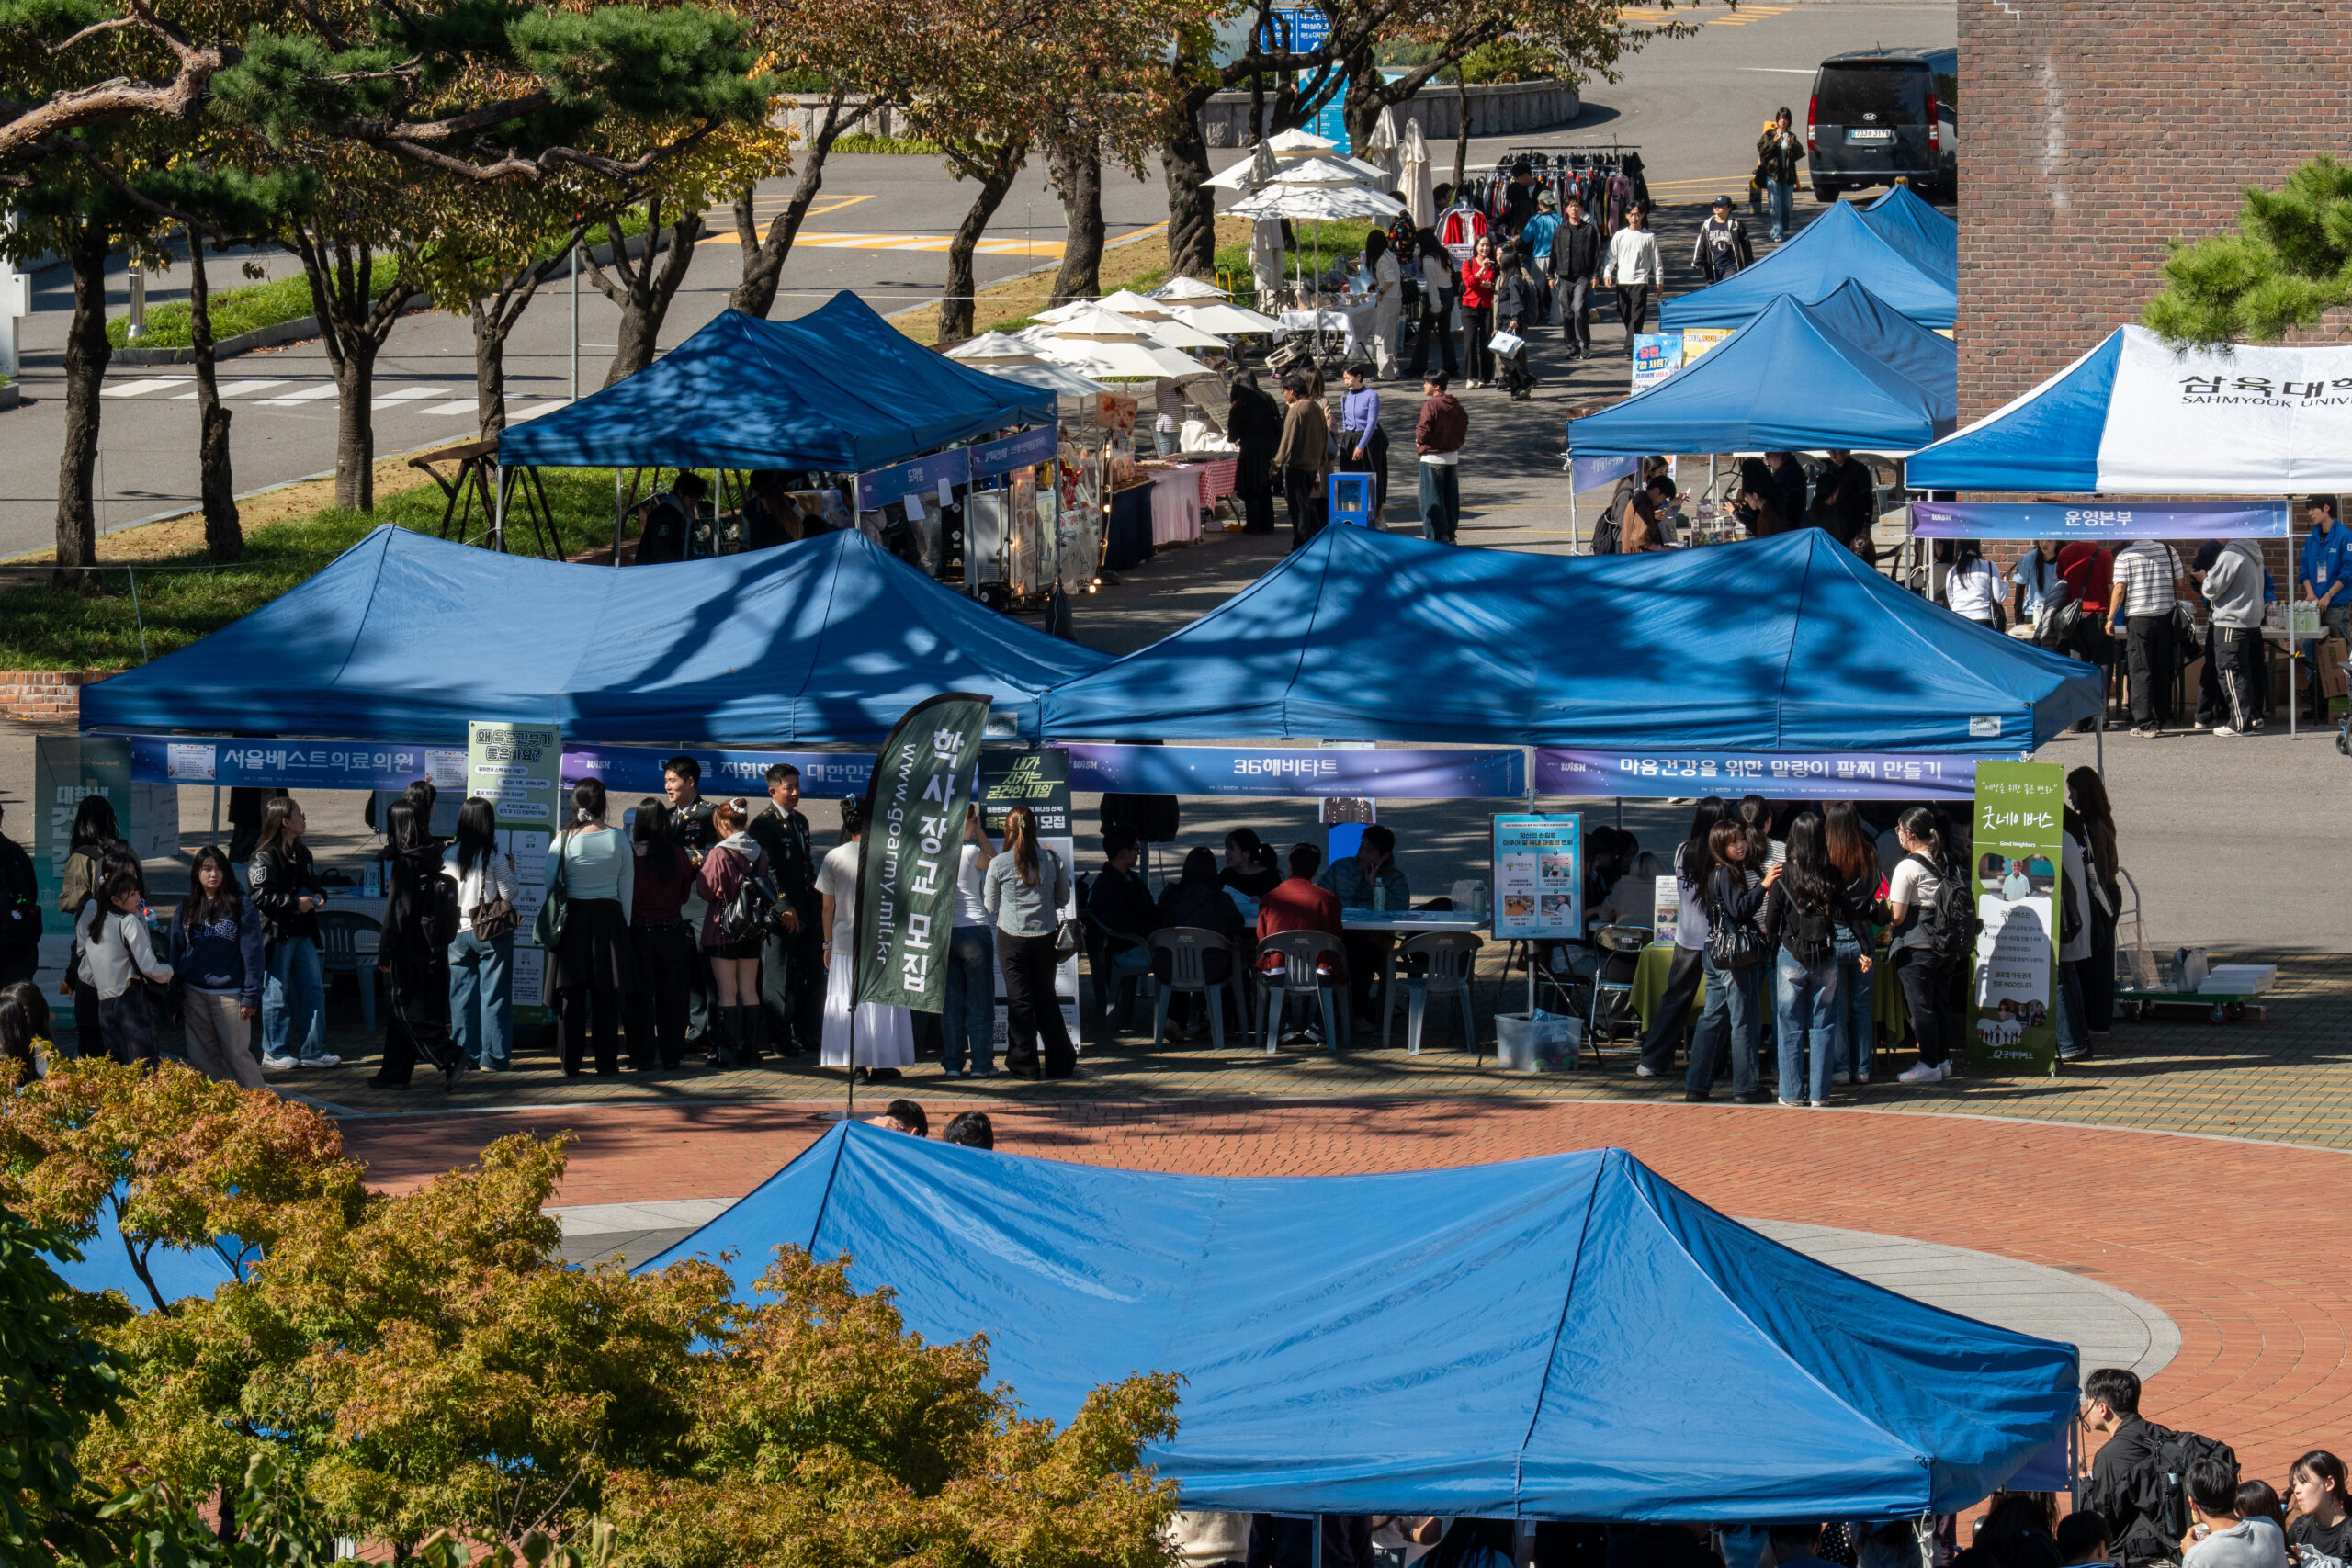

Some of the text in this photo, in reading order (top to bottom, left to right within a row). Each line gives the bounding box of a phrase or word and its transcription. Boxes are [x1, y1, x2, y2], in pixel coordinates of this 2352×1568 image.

[2181, 395, 2352, 409] SAHMYOOK UNIV
[2065, 510, 2132, 527] 운영본부
[477, 730, 553, 747] 왜 육군간부가
[224, 749, 413, 773] 서울베스트의료의원
[486, 747, 542, 762] 좋은가요?
[1012, 756, 1041, 770] 내가
[1233, 758, 1339, 777] 36해비타트
[1620, 759, 1942, 780] 마음건강을 위한 말랑이 팔찌 만들기
[998, 771, 1049, 784] 지키는
[986, 784, 1054, 799] 굳건한 내일
[1040, 815, 1066, 829] 모집
[1982, 805, 2055, 830] 굿네이버스
[876, 743, 916, 964] www.goarmy.mil.kr
[902, 728, 965, 993] 학사장교 모집
